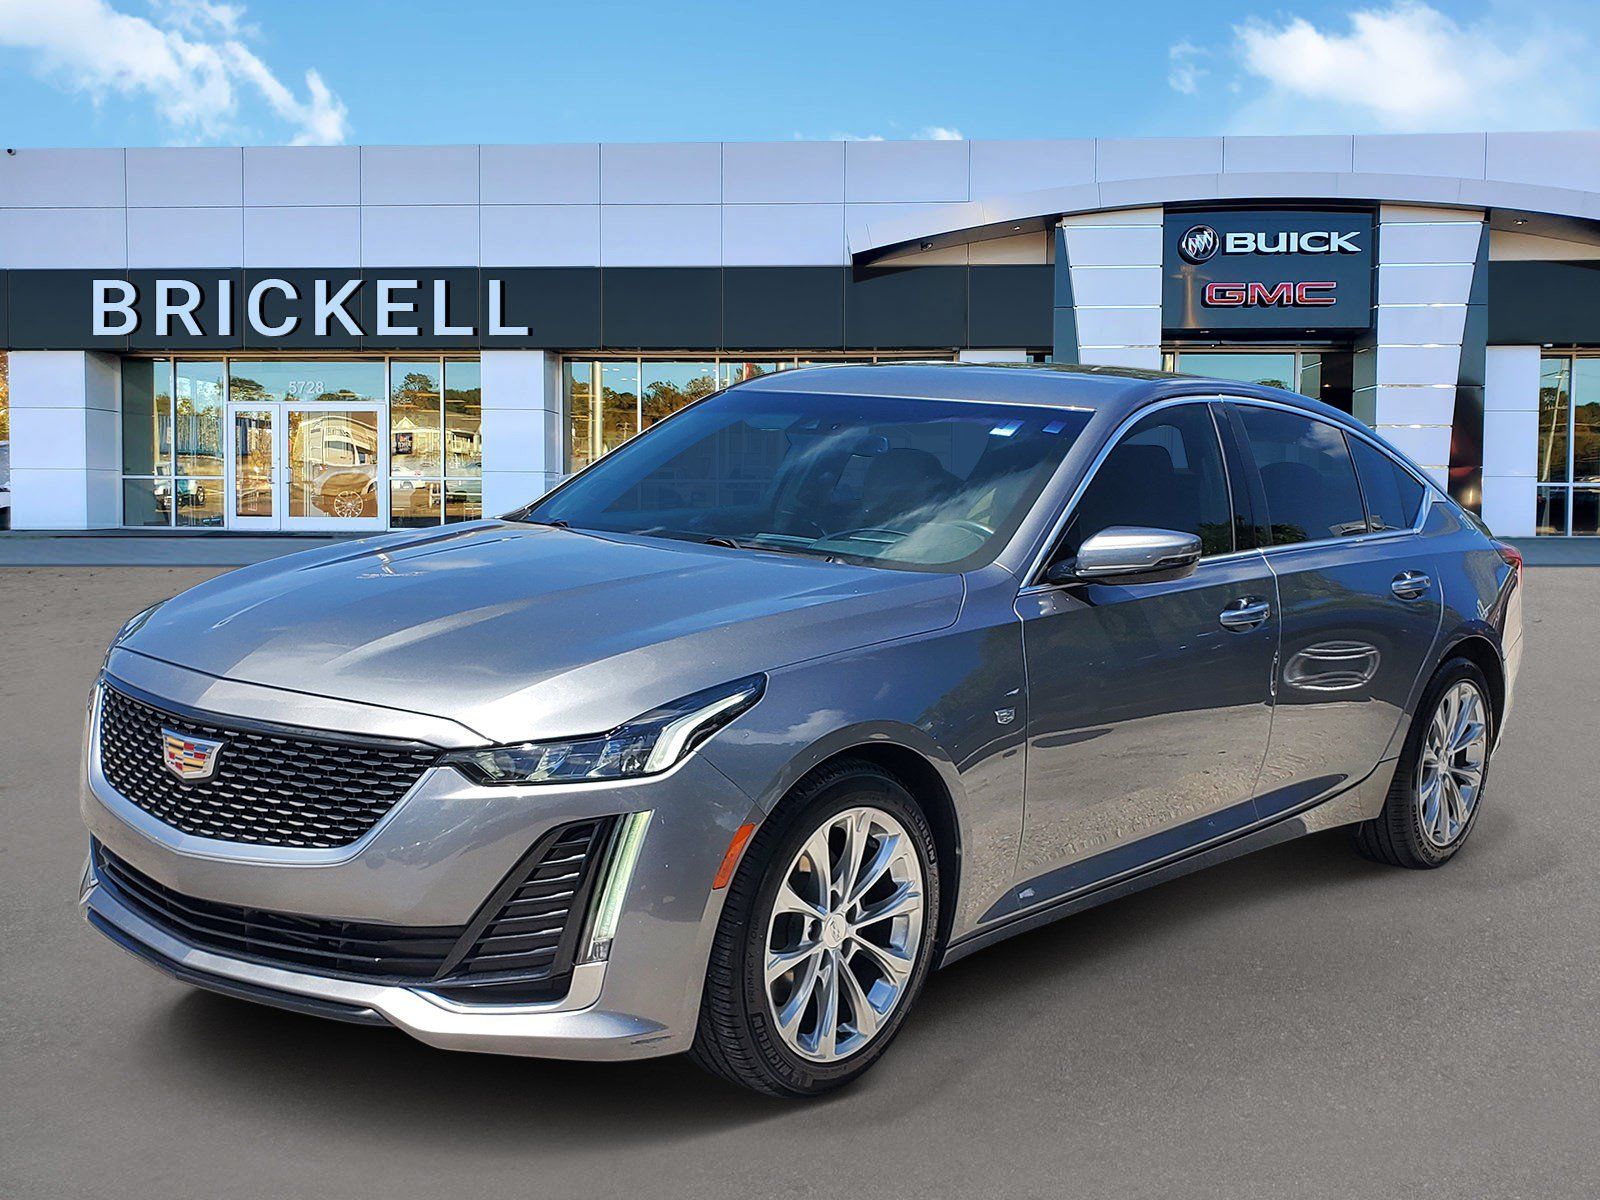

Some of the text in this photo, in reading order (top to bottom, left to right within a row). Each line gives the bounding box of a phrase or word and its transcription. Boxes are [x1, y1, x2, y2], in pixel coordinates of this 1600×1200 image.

[1225, 231, 1362, 253] BUICK
[1205, 282, 1337, 305] GMC
[92, 278, 530, 337] BRICKELL
[288, 380, 325, 395] 5728
[752, 1013, 794, 1077] MICHELIN
